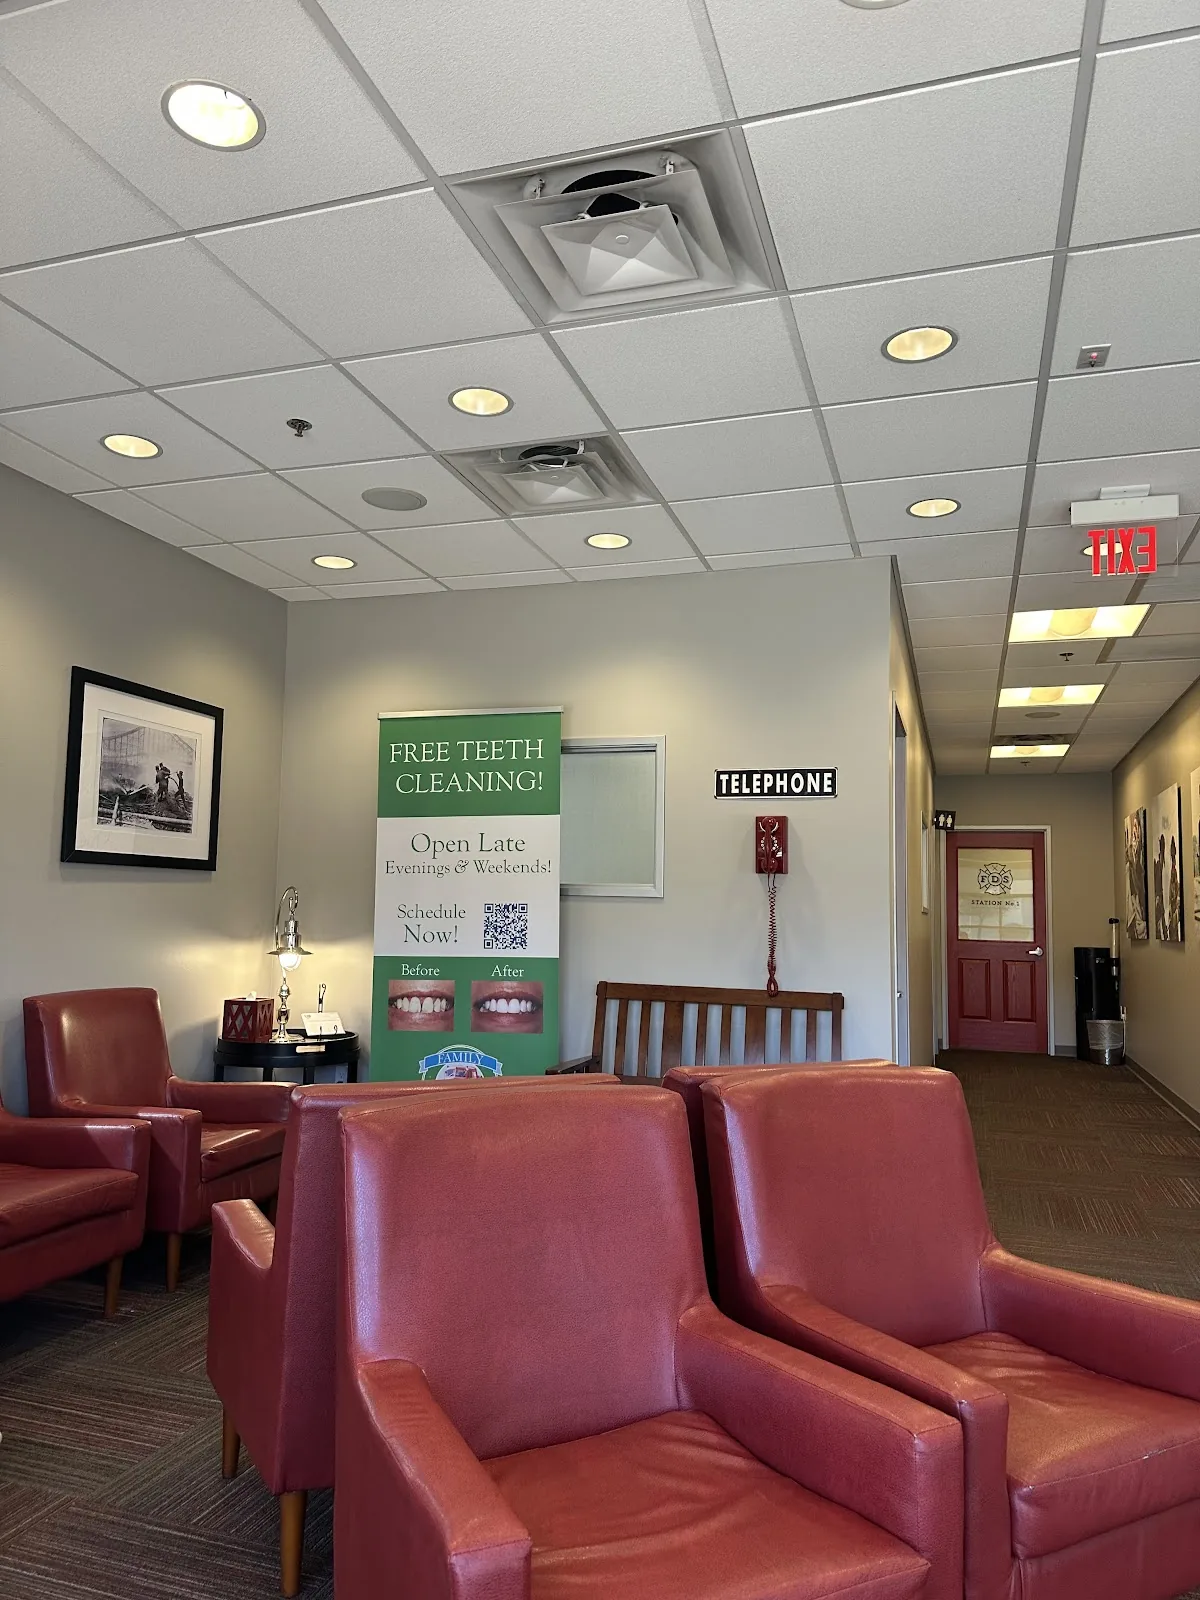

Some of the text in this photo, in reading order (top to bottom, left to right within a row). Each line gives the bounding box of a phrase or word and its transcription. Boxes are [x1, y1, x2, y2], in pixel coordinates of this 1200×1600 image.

[389, 739, 544, 764] FREE TEETH
[395, 770, 543, 794] CLEANING!
[719, 772, 833, 794] TELEPHONE
[411, 832, 526, 860] Open Late
[385, 859, 552, 878] Evenings & Weekends!
[397, 903, 466, 919] Schedule
[403, 924, 459, 944] Now!
[401, 963, 440, 977] Before
[491, 964, 525, 978] After
[438, 1052, 485, 1066] FAMILY
